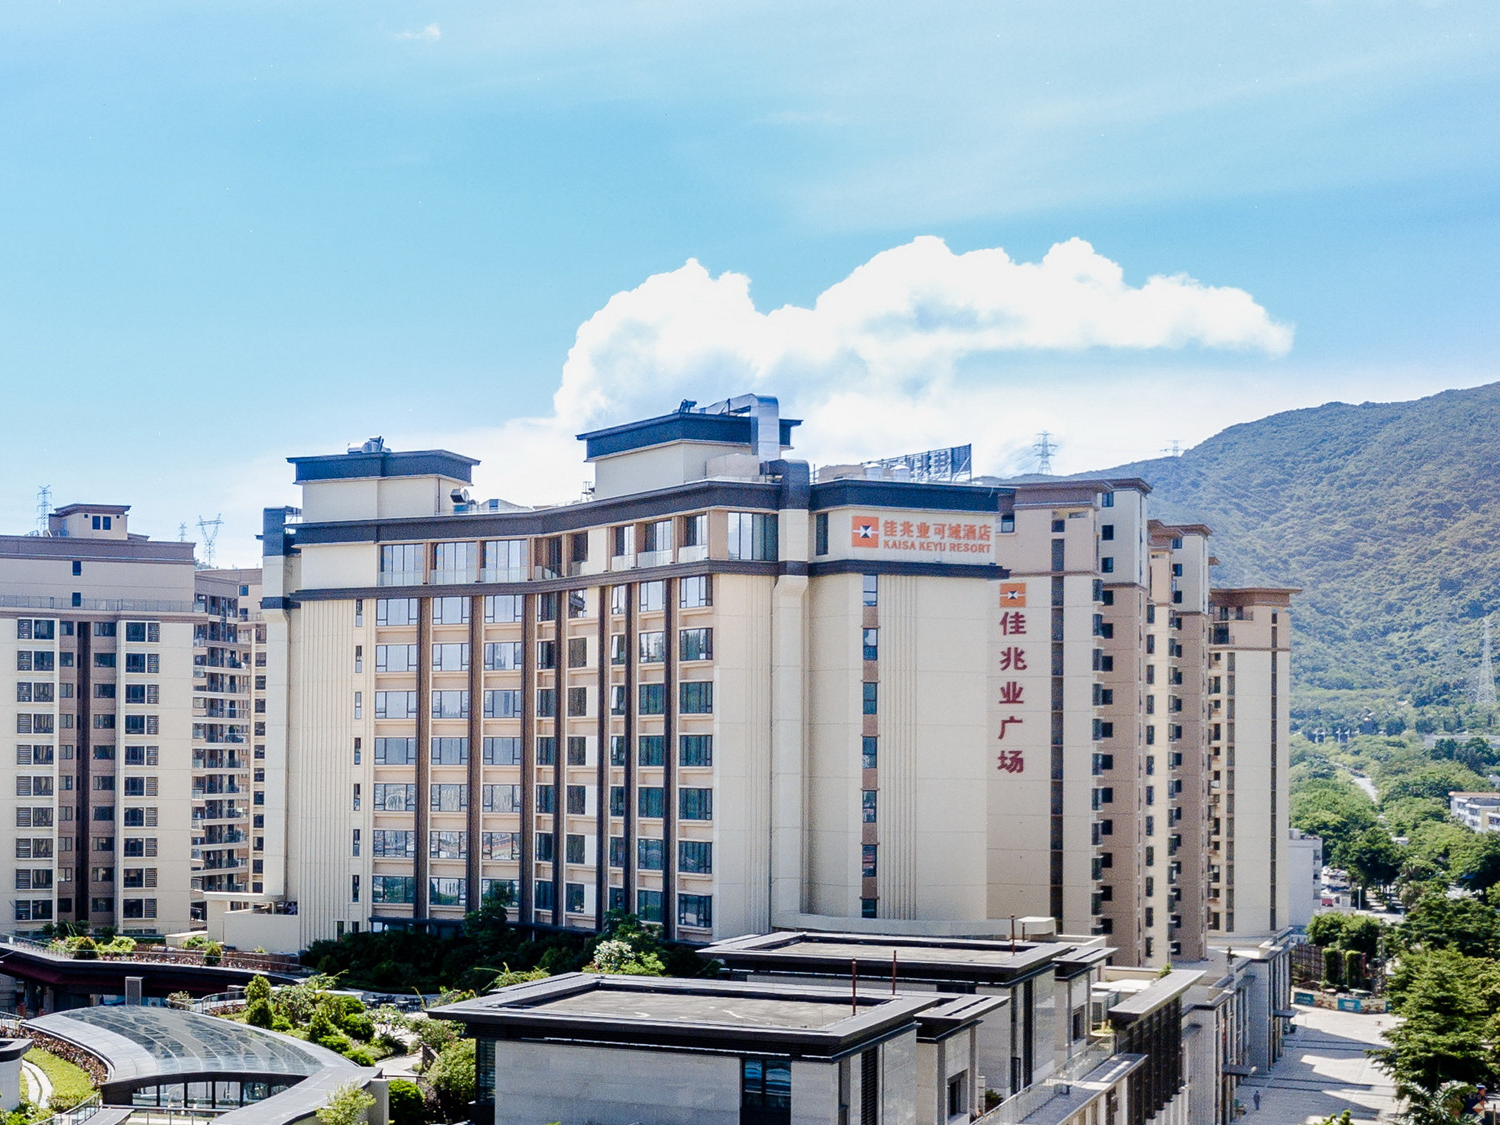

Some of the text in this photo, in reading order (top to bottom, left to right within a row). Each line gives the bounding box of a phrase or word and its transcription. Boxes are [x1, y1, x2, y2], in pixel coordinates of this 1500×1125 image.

[883, 520, 992, 541] 佳兆业可域酒店
[883, 540, 992, 554] KAISA KEYU RESORT
[997, 611, 1027, 773] 佳兆业广场
